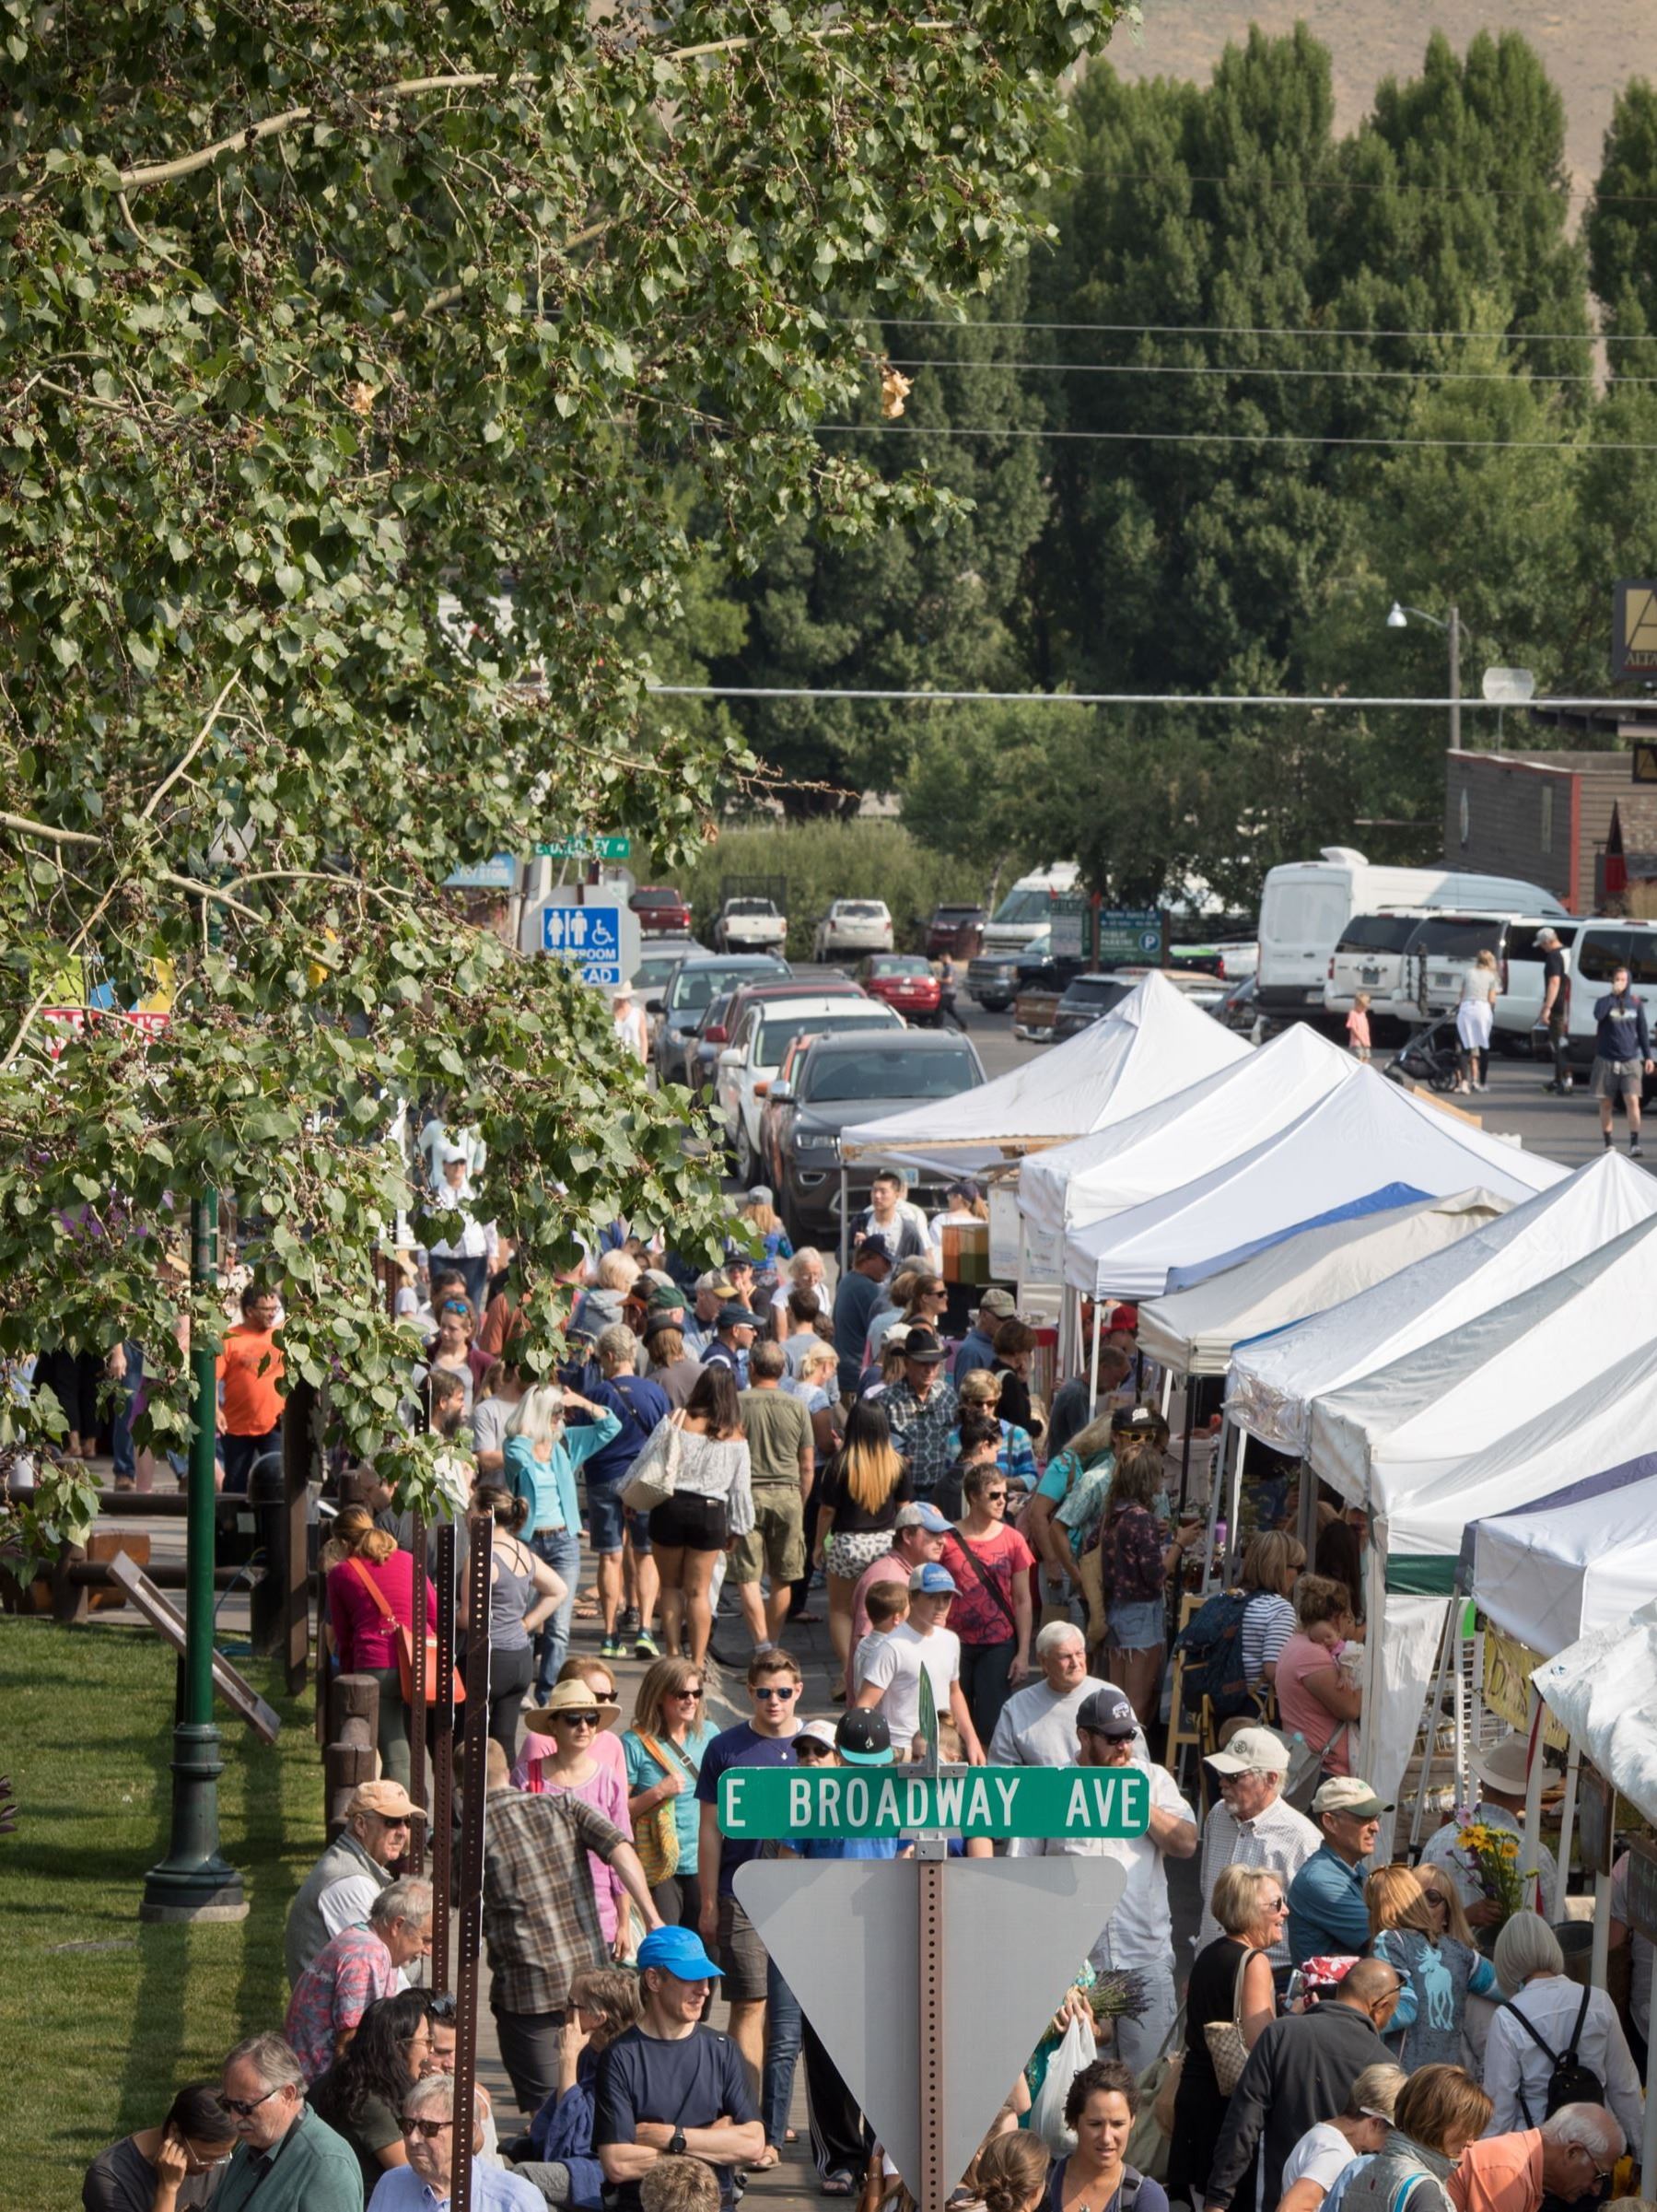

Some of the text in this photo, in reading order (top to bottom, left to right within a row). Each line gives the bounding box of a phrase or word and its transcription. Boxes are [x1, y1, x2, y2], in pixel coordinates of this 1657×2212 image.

[546, 948, 616, 960] ROOM
[726, 1777, 1142, 1828] E BROADWAY AVE
